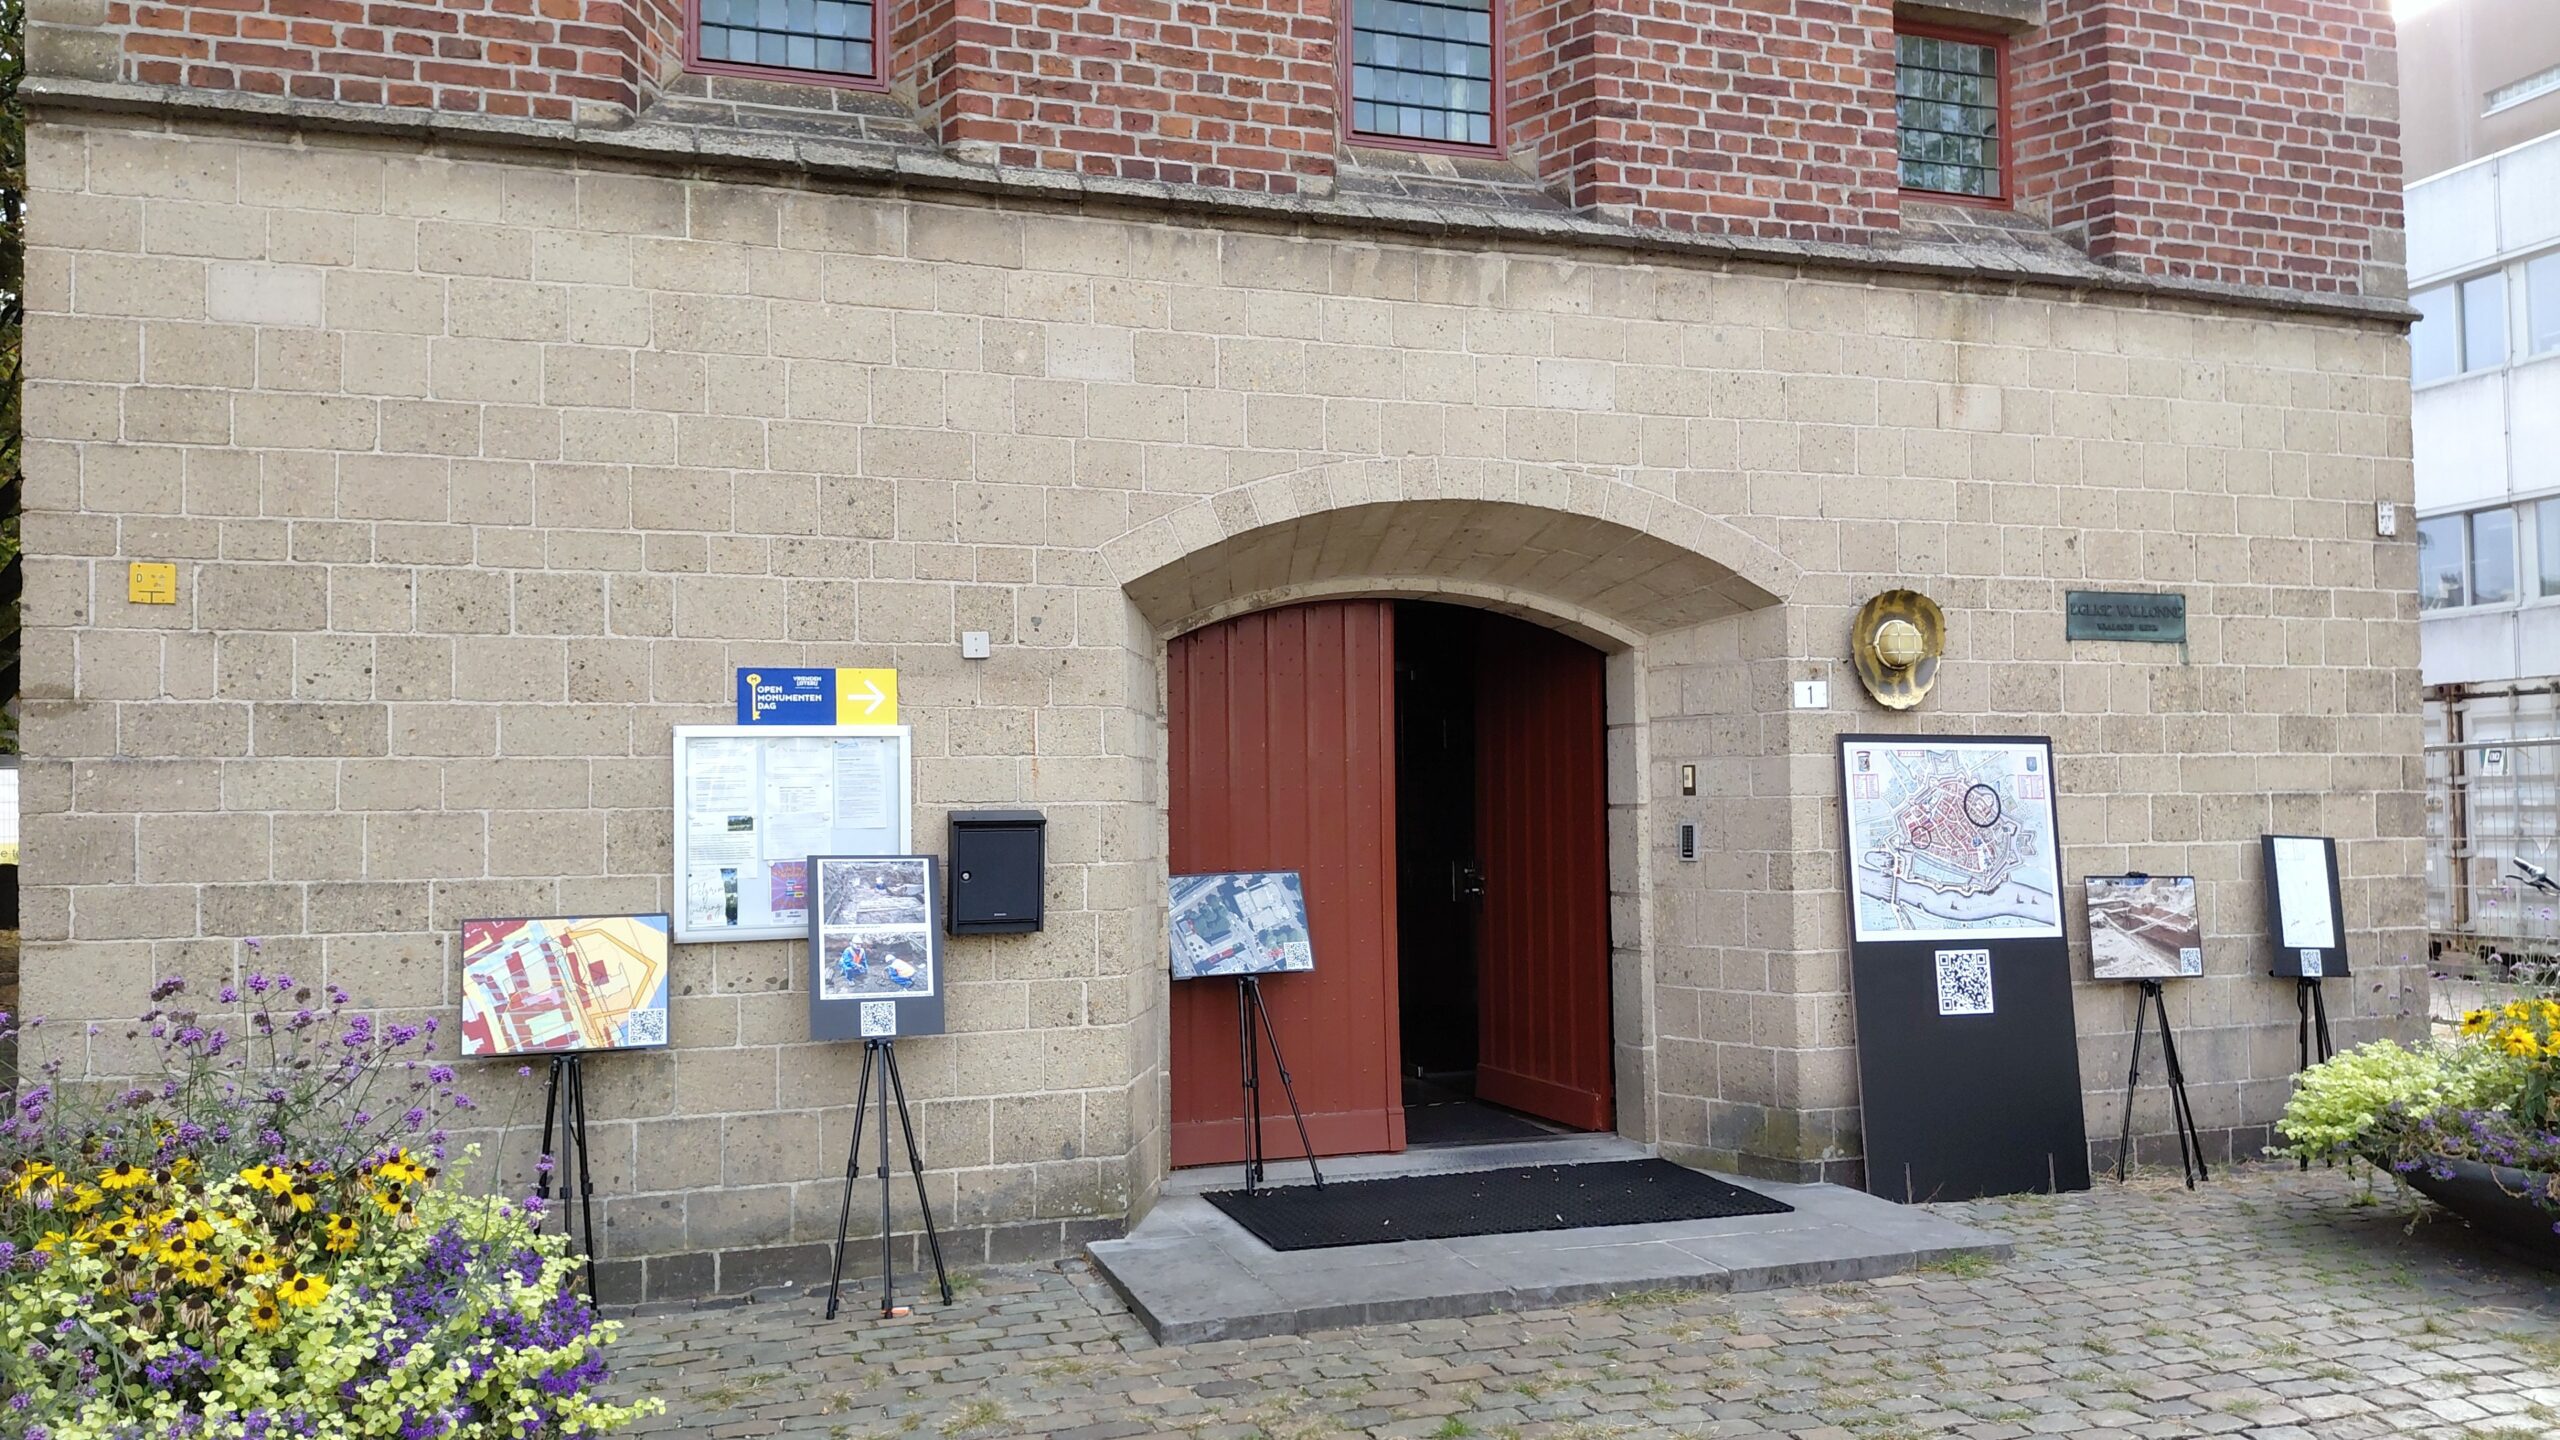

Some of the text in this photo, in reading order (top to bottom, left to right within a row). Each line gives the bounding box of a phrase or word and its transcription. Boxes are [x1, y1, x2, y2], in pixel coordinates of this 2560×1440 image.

[757, 685, 782, 694] OPEN
[757, 693, 822, 702] MONUMENTEN
[1808, 685, 1812, 704] 1
[757, 702, 776, 710] DAG
